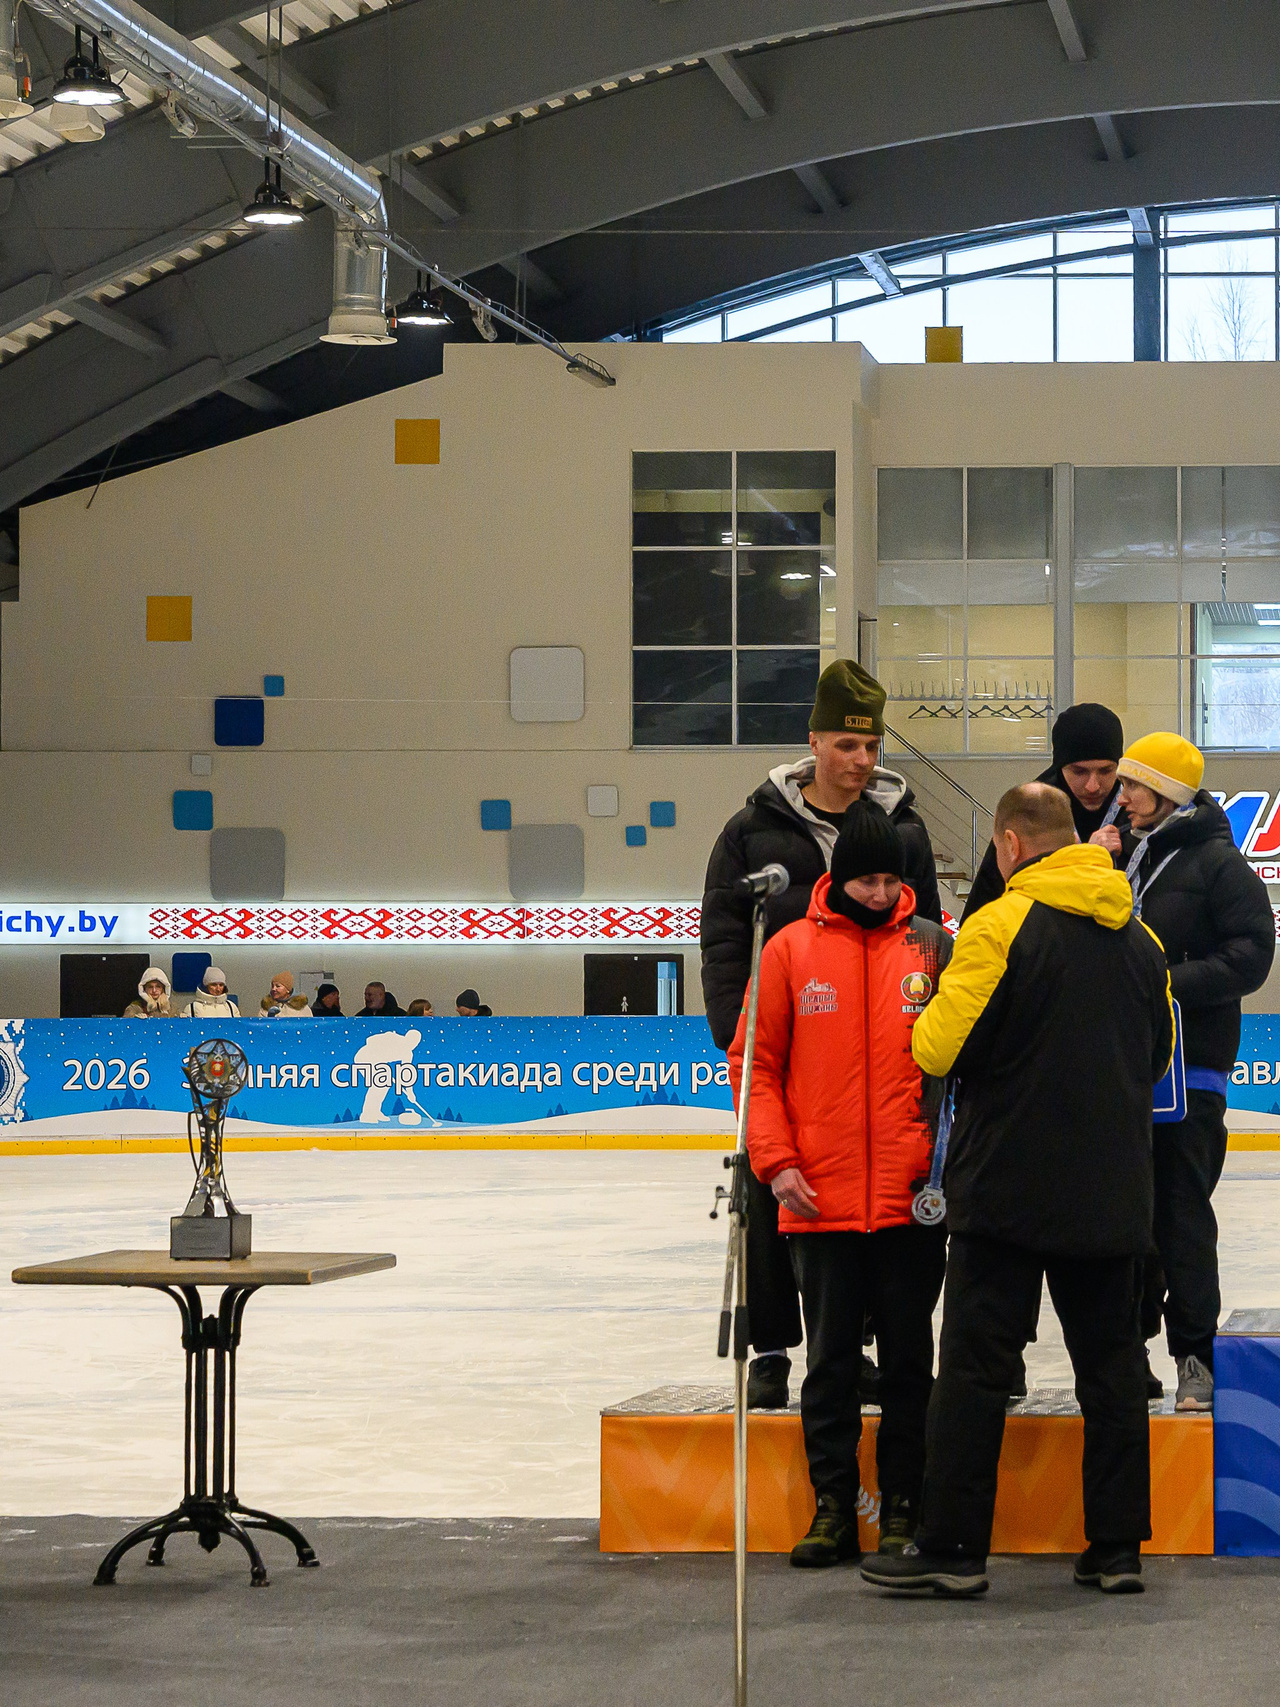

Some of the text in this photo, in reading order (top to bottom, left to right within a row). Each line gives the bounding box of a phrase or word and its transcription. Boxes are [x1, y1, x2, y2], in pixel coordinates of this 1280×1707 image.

[62, 1058, 150, 1091] 2026
[331, 1061, 562, 1095] спартакиада
[572, 1061, 680, 1094] среди
